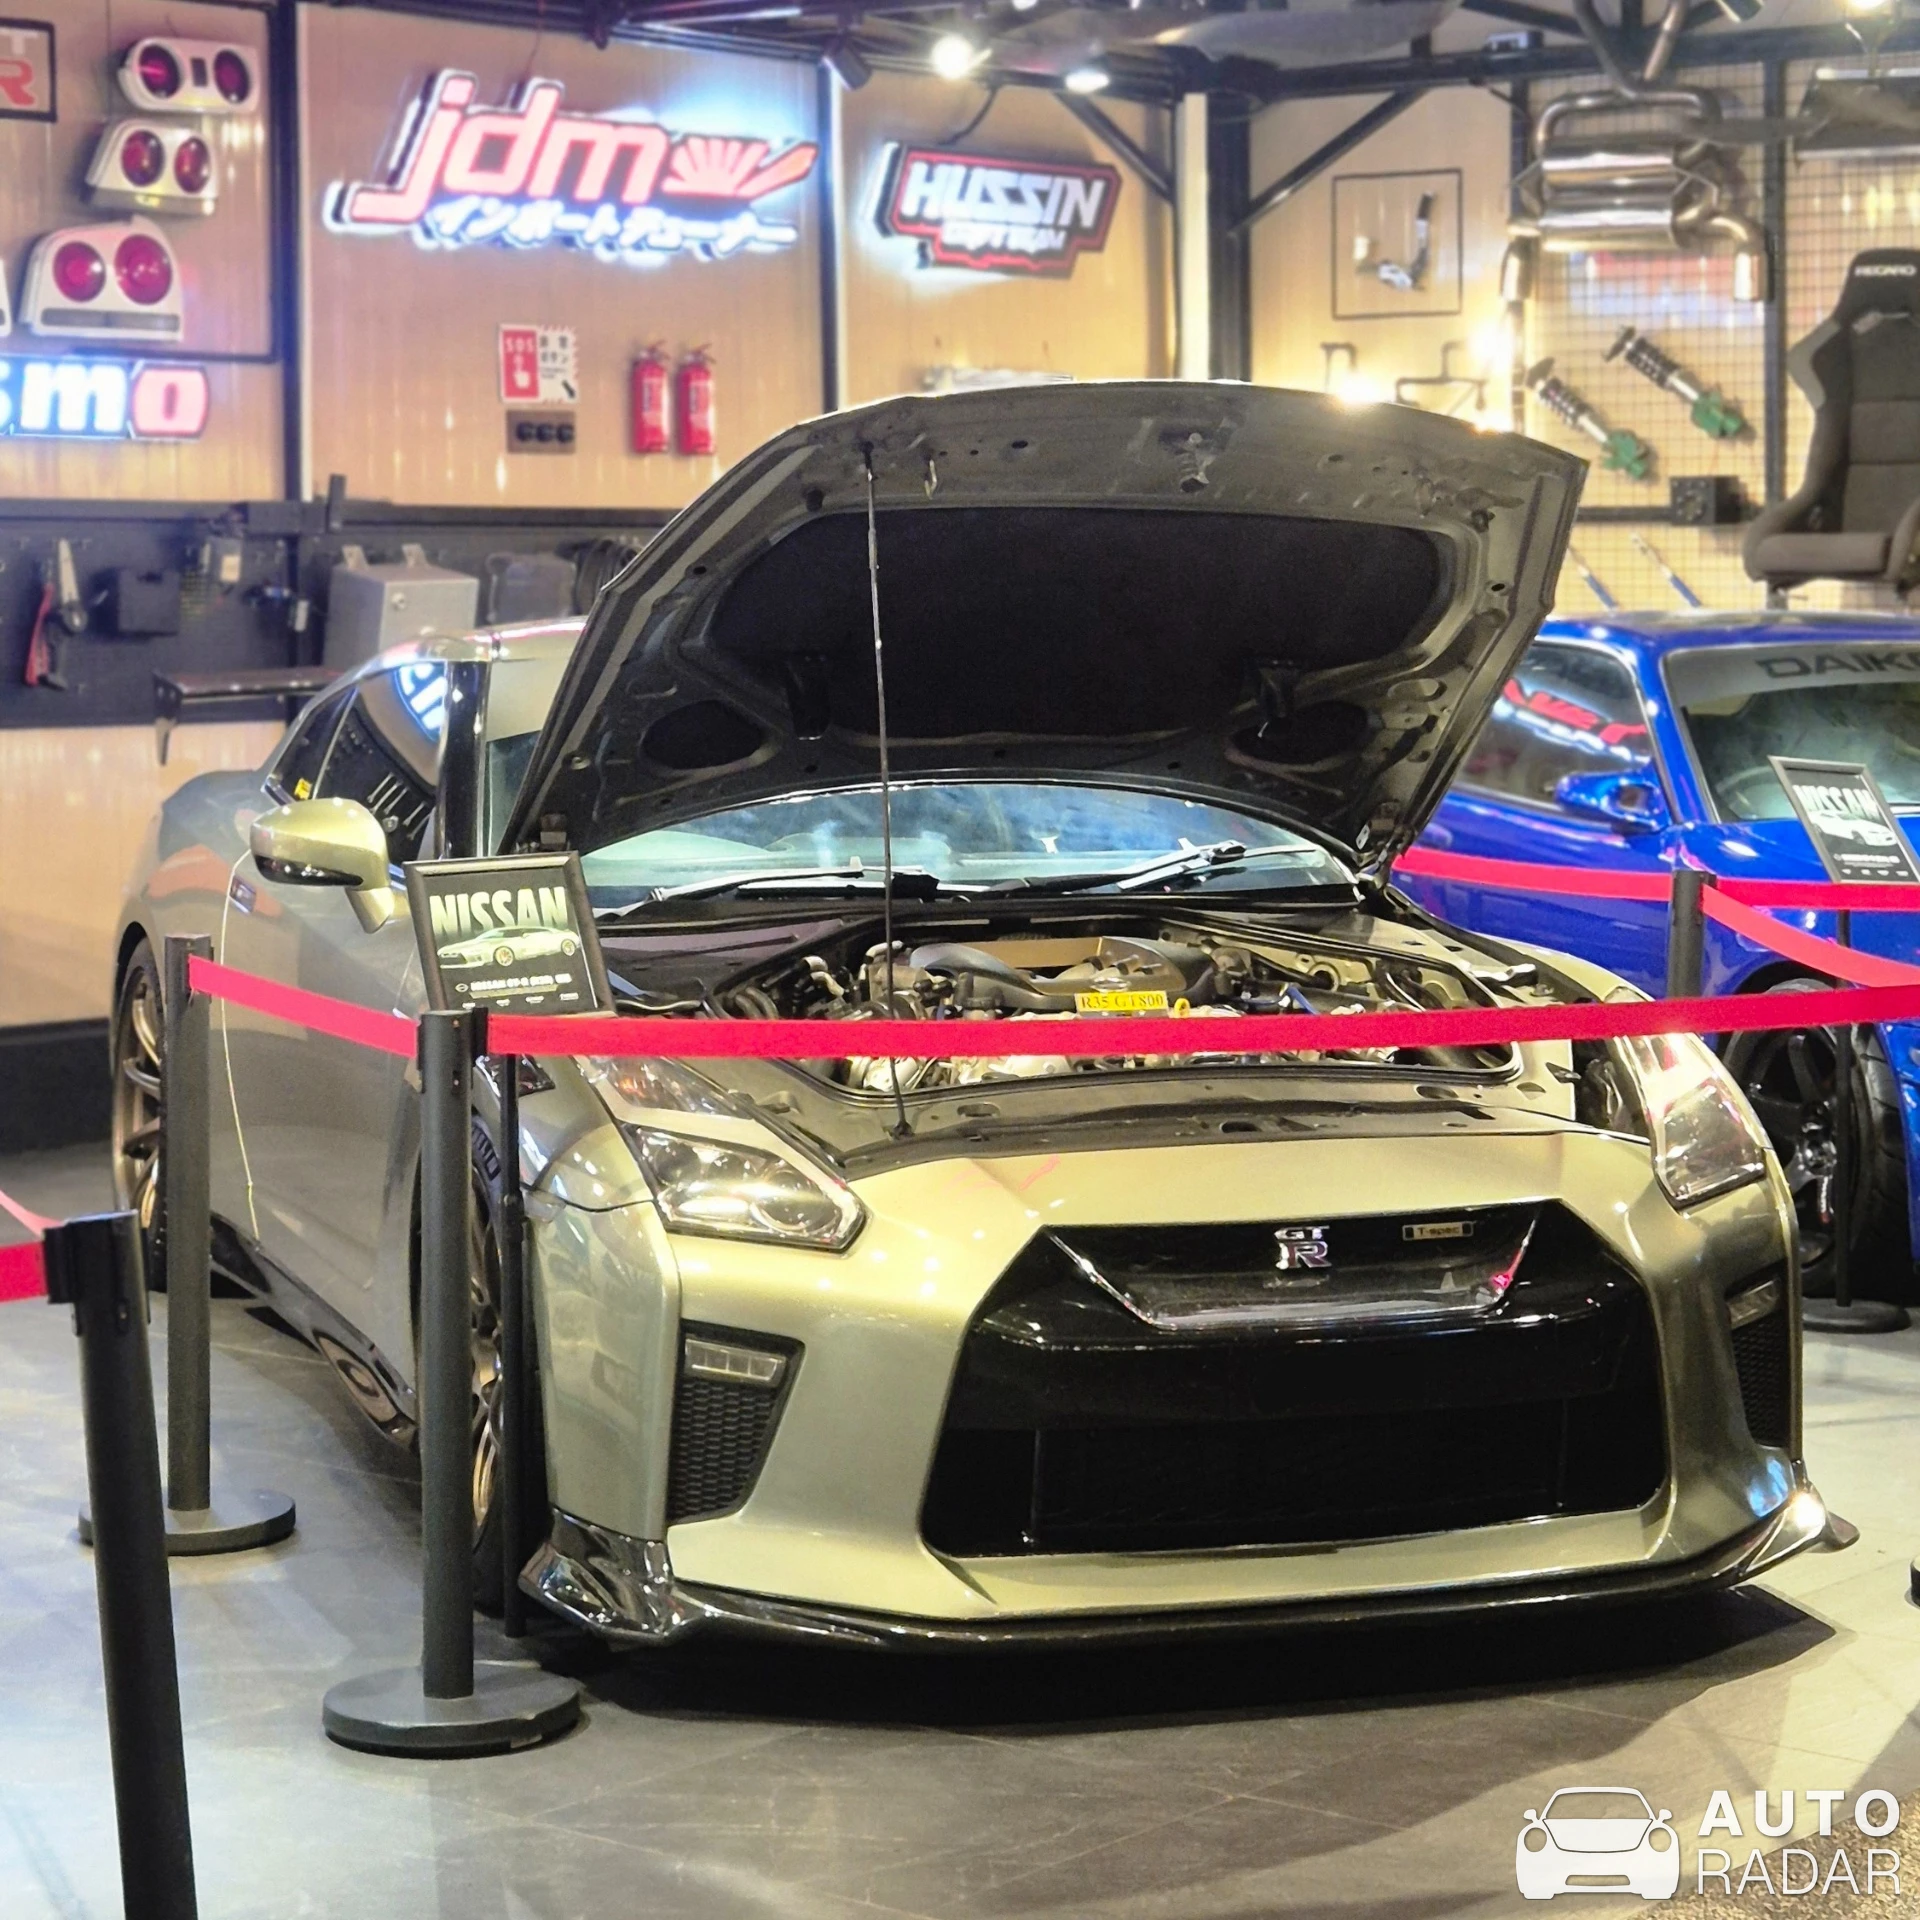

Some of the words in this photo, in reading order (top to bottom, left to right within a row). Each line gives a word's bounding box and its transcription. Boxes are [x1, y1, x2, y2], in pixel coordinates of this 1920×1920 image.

[350, 73, 669, 223] jdm
[900, 160, 1105, 229] HUSSIN
[0, 360, 209, 434] mo
[1792, 784, 1881, 821] NISSAN
[429, 886, 569, 939] NISSAN
[1081, 996, 1110, 1009] R35
